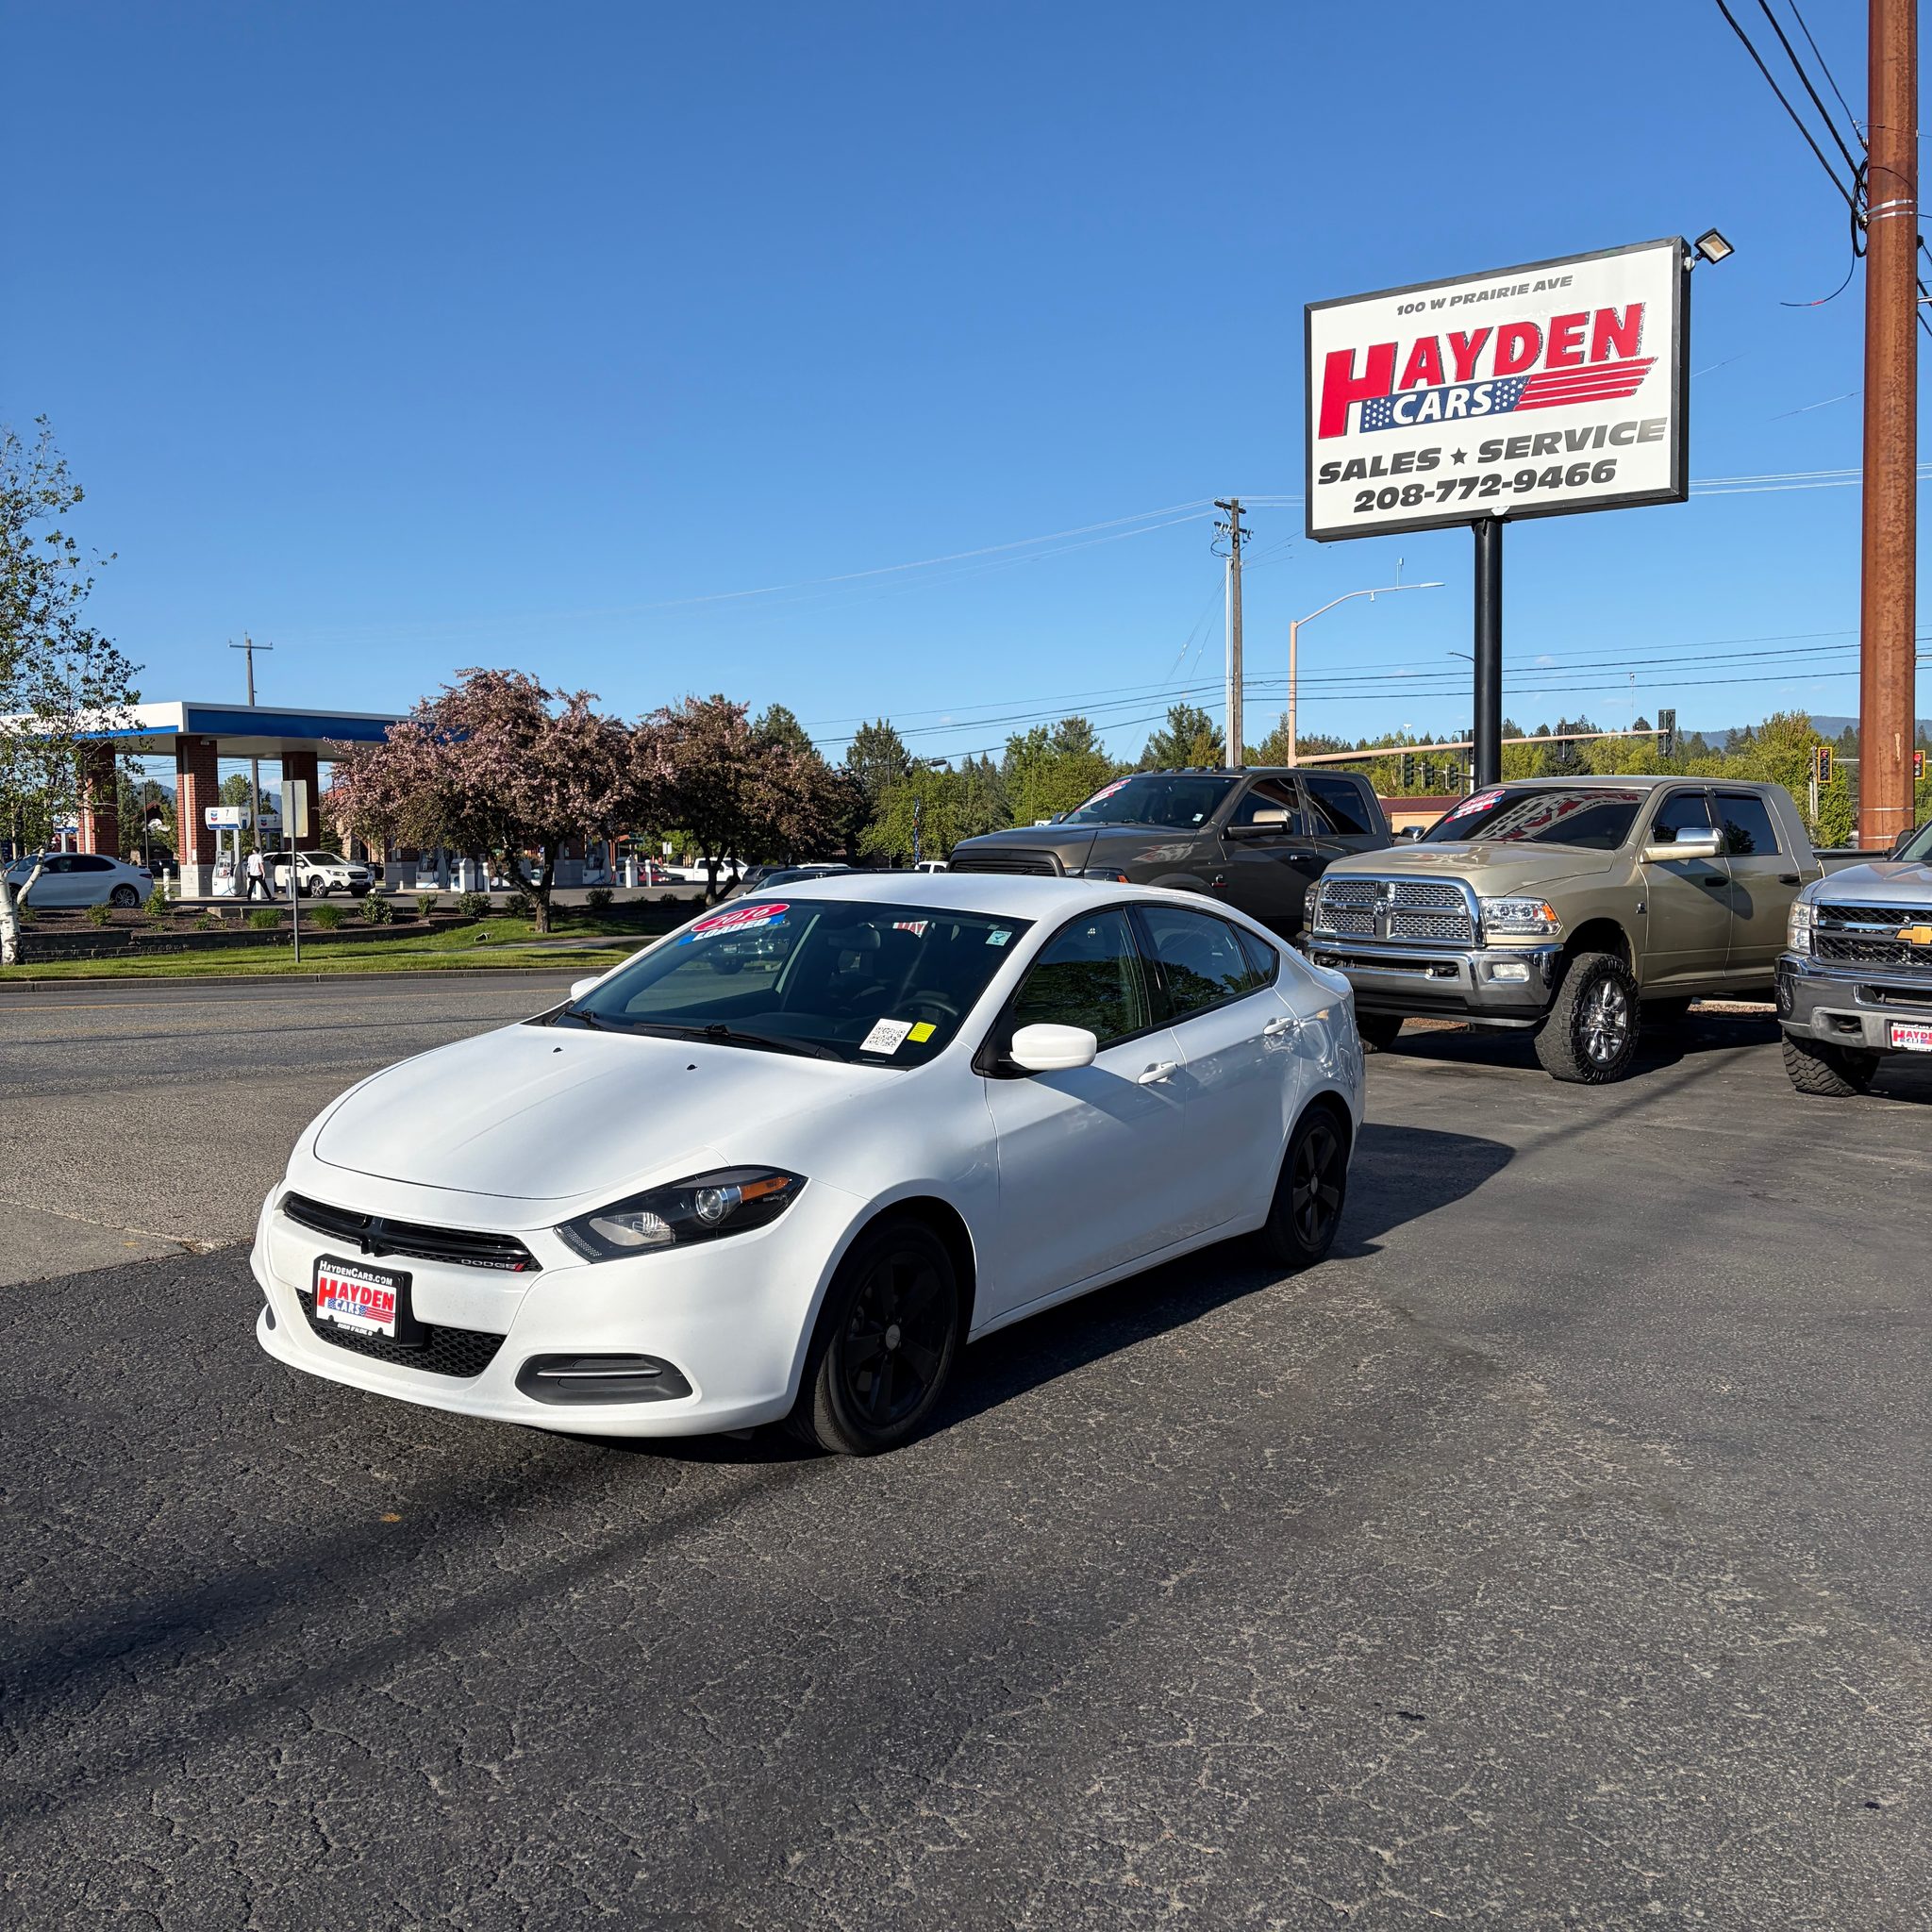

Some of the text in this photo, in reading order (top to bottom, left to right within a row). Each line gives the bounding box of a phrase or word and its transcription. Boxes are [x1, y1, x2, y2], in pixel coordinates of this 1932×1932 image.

[1397, 275, 1574, 316] 100 W PRAIRIE AVE
[1318, 302, 1646, 440] HAYDEN
[1392, 382, 1494, 425] CARS
[1318, 417, 1668, 485] SALES SERVICE
[1353, 458, 1618, 513] 208-772-9466
[691, 918, 772, 941] LOADED
[704, 908, 771, 929] 2016
[461, 1258, 516, 1270] DODGE
[317, 1276, 394, 1311] HAYDEN
[335, 1299, 360, 1315] CARS
